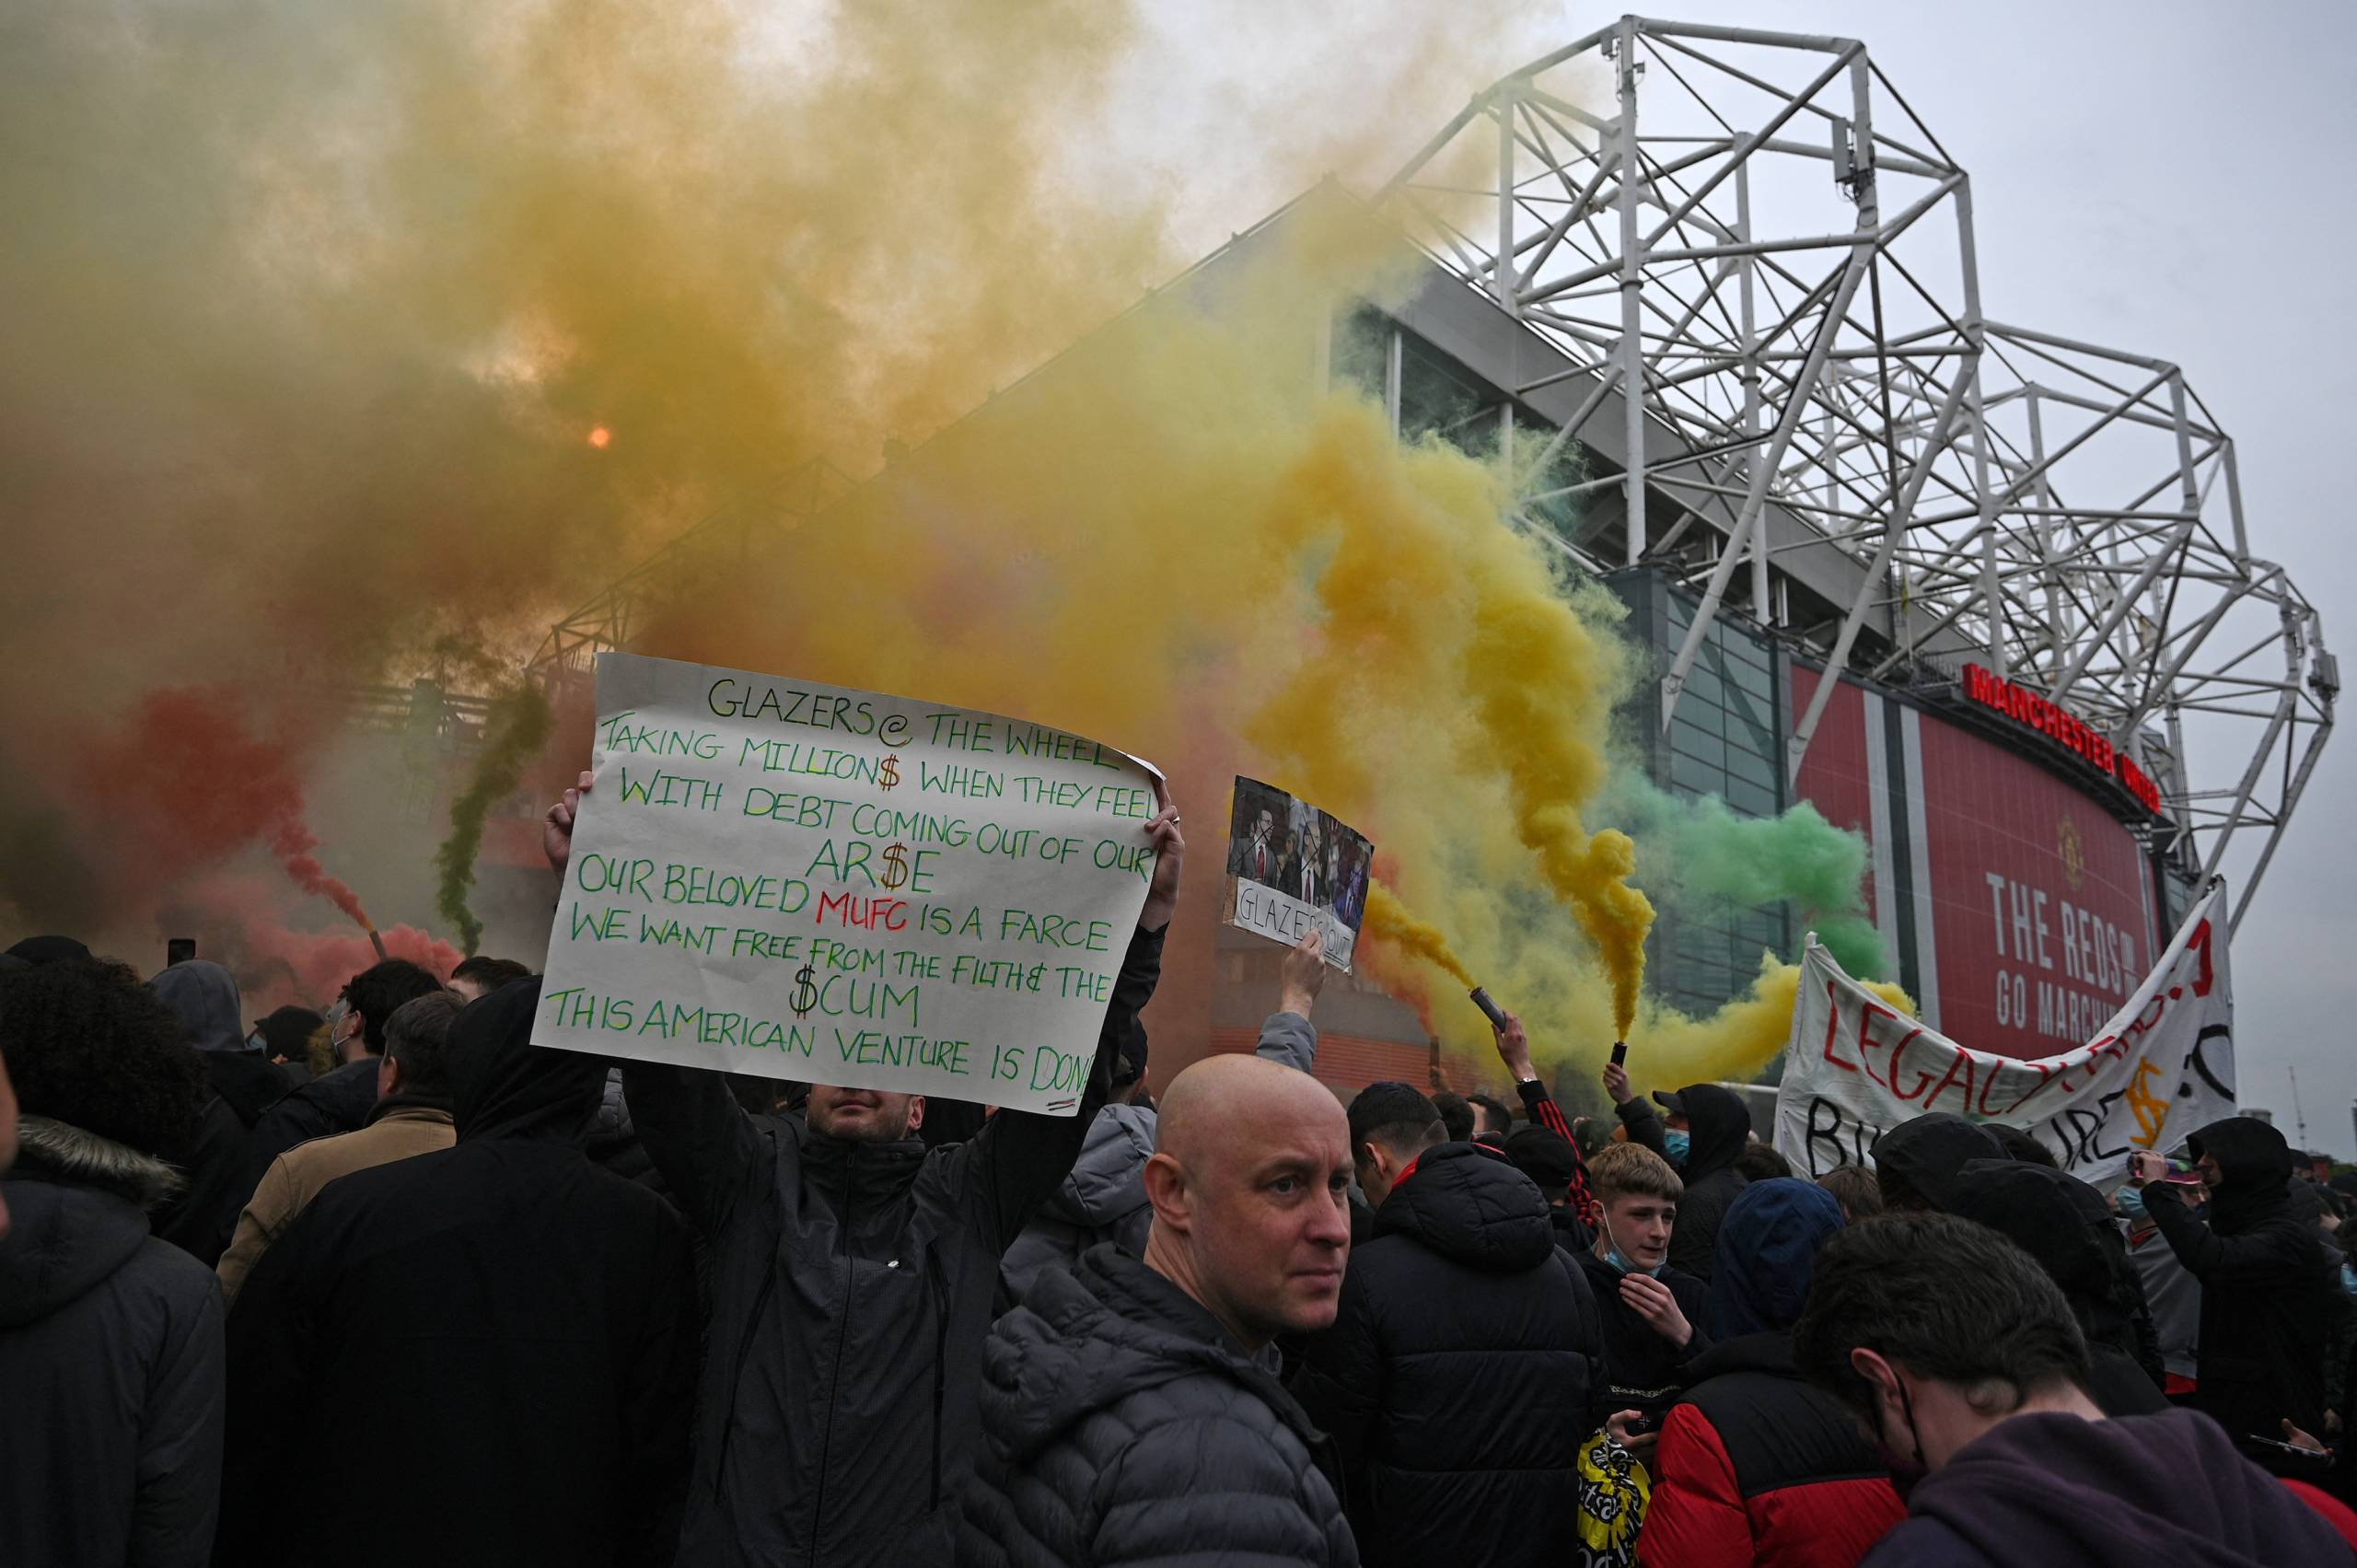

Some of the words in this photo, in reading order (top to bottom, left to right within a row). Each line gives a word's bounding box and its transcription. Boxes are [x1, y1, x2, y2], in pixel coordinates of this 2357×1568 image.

[601, 712, 724, 759] TAKING
[739, 738, 900, 792] MILLION$
[921, 761, 1004, 798] WHEN
[1014, 776, 1093, 808] THEY
[1096, 786, 1154, 821] FEEL
[708, 679, 875, 734] GLAZERS
[926, 714, 993, 752] THE
[1005, 724, 1120, 770] WHEEL
[1963, 663, 2115, 775] MANCHESTER
[621, 767, 723, 811] WITH
[744, 787, 853, 829] DEBT
[853, 804, 971, 847] COMING
[976, 822, 1039, 859] OUT
[1039, 837, 1084, 864] OF
[1093, 840, 1154, 882] OUR
[806, 839, 940, 894] AR$E
[578, 854, 654, 902] OUR
[663, 864, 810, 913] BELOVED
[815, 890, 908, 931] MUFC
[921, 904, 953, 935] IS
[958, 906, 982, 941] A
[1002, 910, 1112, 951] FARCE
[1327, 929, 1350, 958] OUT
[1986, 872, 2052, 970] THE
[2061, 900, 2121, 996] REDS
[571, 901, 631, 942] WE
[640, 913, 726, 955] WANT
[732, 928, 802, 959] FREE
[810, 938, 884, 977] FROM
[893, 951, 941, 980] THE
[952, 956, 1023, 992] FILTH
[1056, 967, 1111, 1003] THE
[789, 963, 919, 1028] $CUM
[1997, 970, 2026, 1029] GO
[545, 987, 634, 1030] THIS
[638, 1000, 815, 1058] AMERICAN
[835, 1028, 970, 1075] VENTURE
[992, 1044, 1024, 1080] IS
